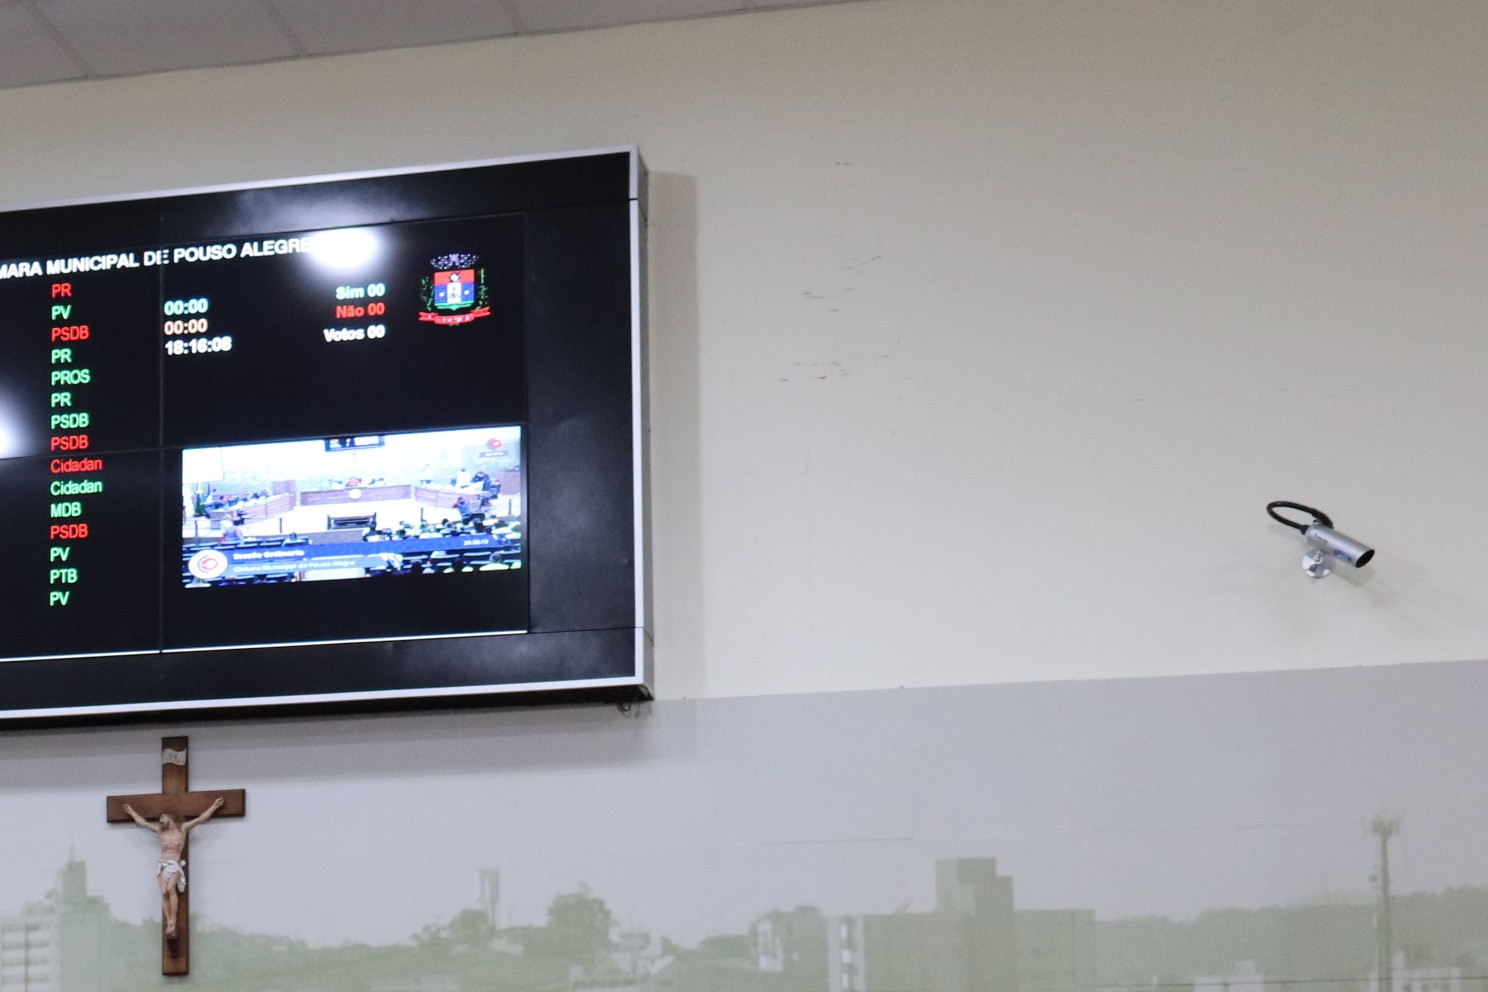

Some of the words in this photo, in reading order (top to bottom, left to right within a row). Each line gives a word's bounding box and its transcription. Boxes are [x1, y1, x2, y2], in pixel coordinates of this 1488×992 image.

[46, 253, 140, 275] MUNICIPAL
[174, 243, 237, 263] POUSO
[240, 238, 311, 258] ALEGRE
[52, 283, 72, 298] PR
[335, 286, 364, 300] Sim
[368, 283, 385, 297] 00
[52, 305, 71, 320] PV
[164, 297, 209, 315] 00:00
[335, 305, 366, 318] Não
[366, 302, 386, 316] 00
[52, 325, 90, 341] PSDB
[164, 318, 208, 335] 00:00
[323, 327, 365, 342] Votos
[367, 324, 386, 339] 00
[52, 348, 72, 364] PR
[51, 369, 91, 385] PROS
[51, 392, 72, 407] PR
[51, 412, 89, 429] PSDB
[50, 435, 89, 451] PSDB
[50, 458, 103, 474] Cidadan
[50, 479, 103, 495] Cidadan
[51, 502, 82, 517] MDB
[50, 523, 88, 539] PSDB
[50, 547, 70, 562] PV
[50, 568, 78, 584] PTB
[50, 591, 70, 606] PV
